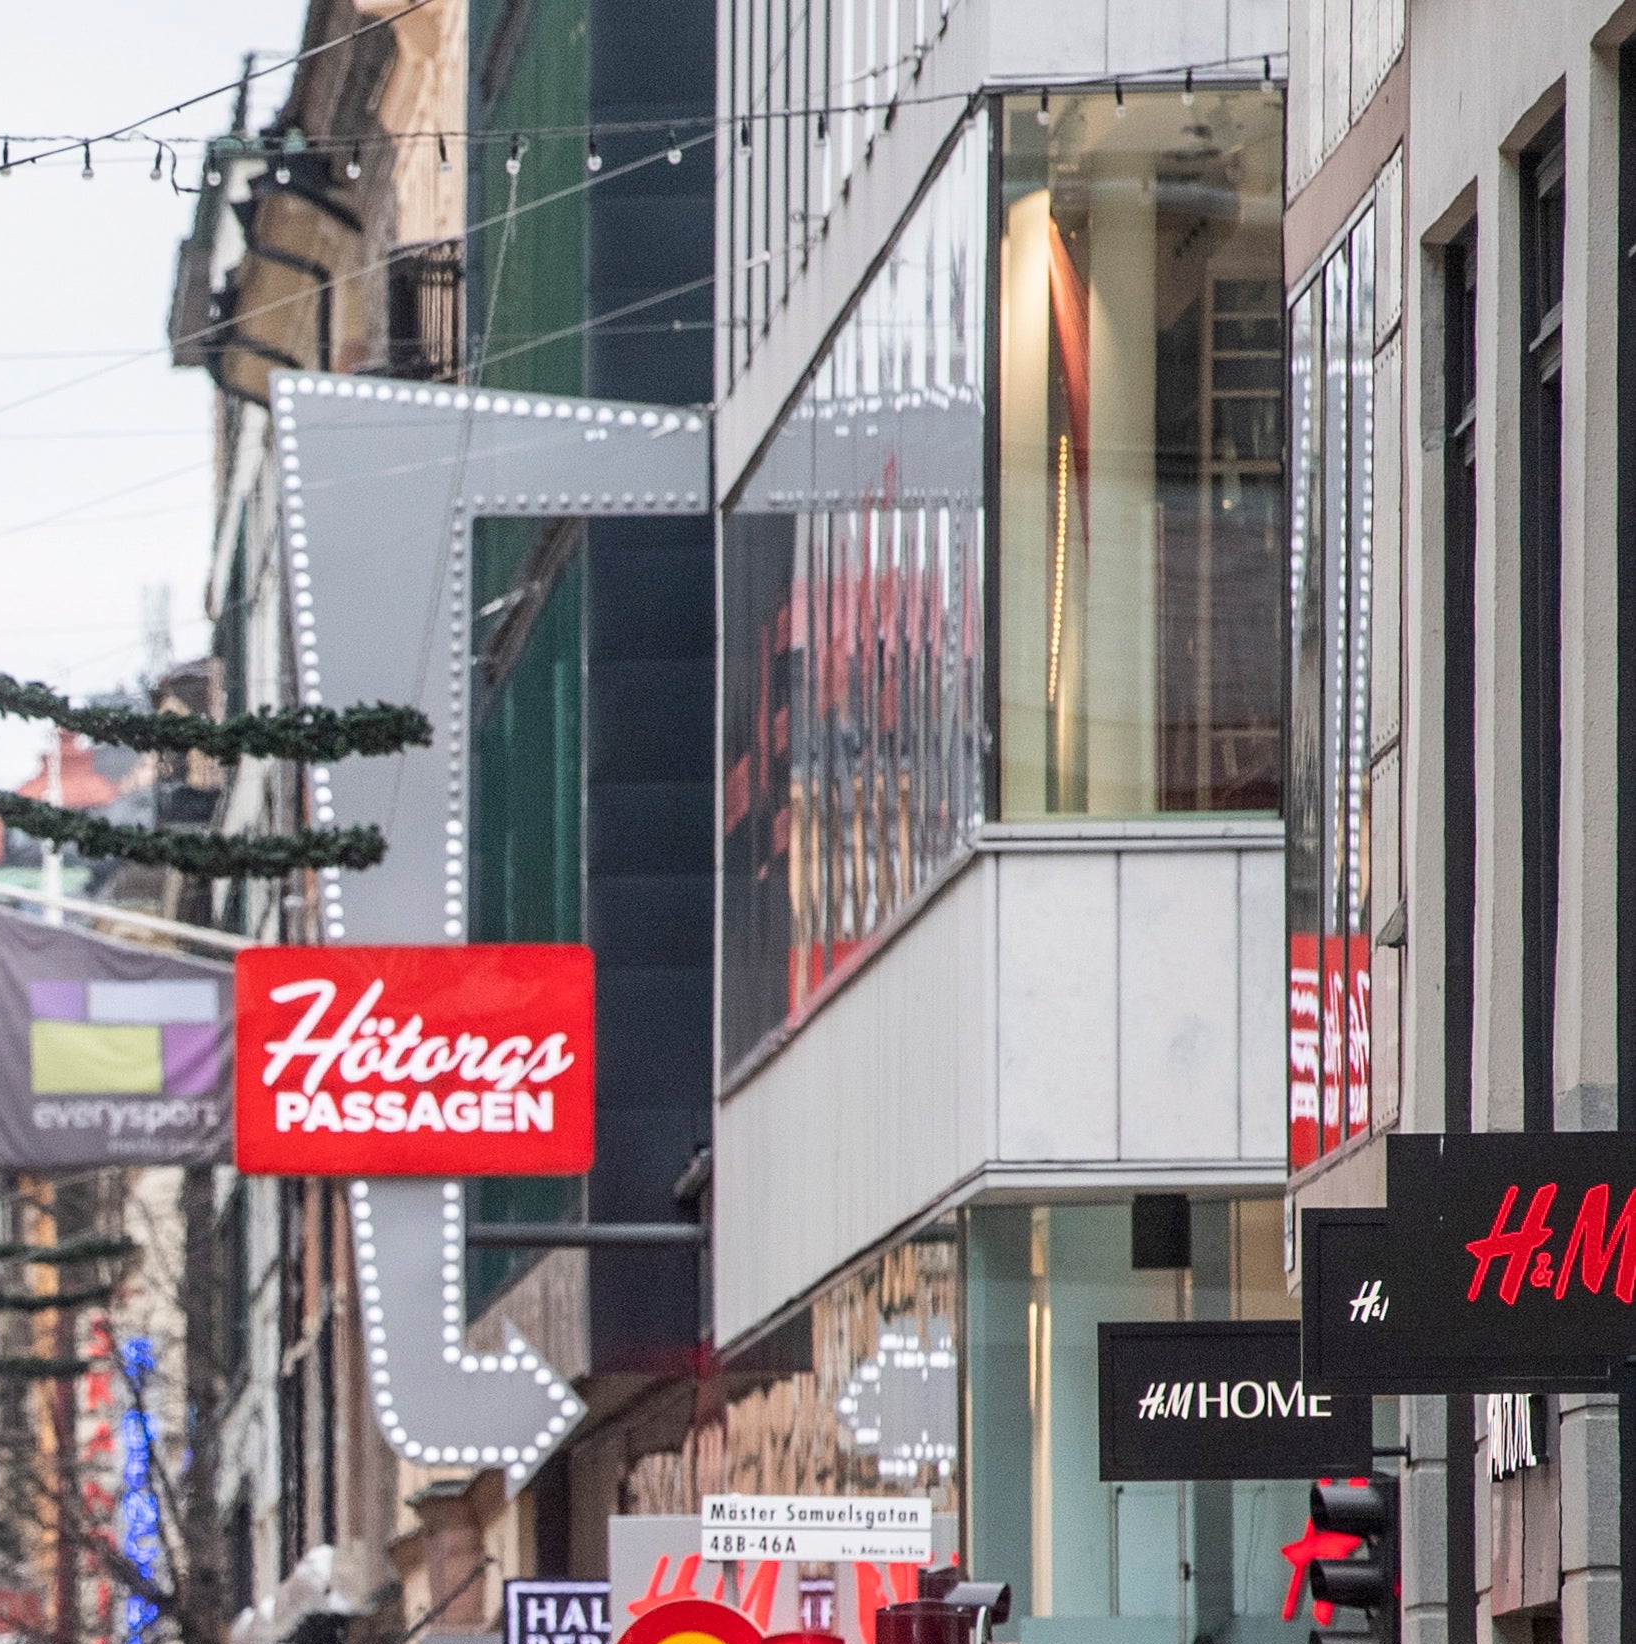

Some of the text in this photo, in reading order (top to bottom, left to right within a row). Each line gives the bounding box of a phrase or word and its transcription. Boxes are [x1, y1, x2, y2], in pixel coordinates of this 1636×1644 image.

[262, 978, 575, 1097] Hötorgs
[276, 1091, 553, 1133] PASSAGEN
[1466, 1182, 1636, 1306] H&M
[1138, 1380, 1332, 1420] H&M HOME
[710, 1503, 919, 1529] Mäster Samuelsgatan
[710, 1536, 797, 1554] 48B-46A
